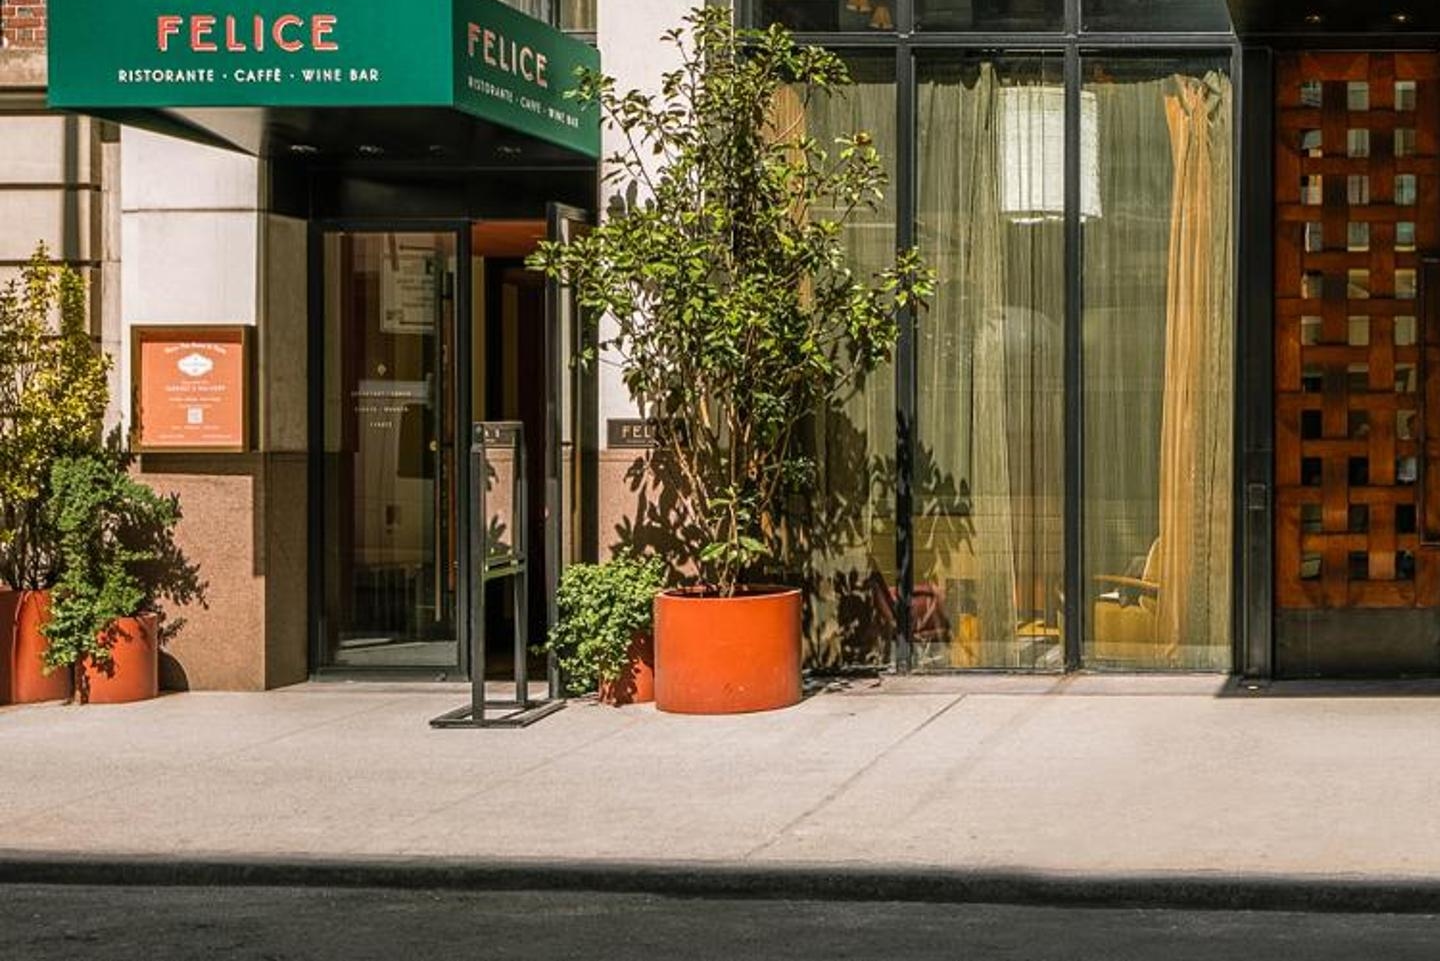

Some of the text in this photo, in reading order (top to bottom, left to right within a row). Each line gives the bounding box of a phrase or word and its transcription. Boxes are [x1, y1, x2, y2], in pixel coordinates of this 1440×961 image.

[156, 14, 339, 52] FELICE
[467, 22, 548, 89] FELICE
[118, 69, 214, 83] RISTORANTE
[302, 69, 342, 83] WINE
[350, 69, 379, 83] BAR
